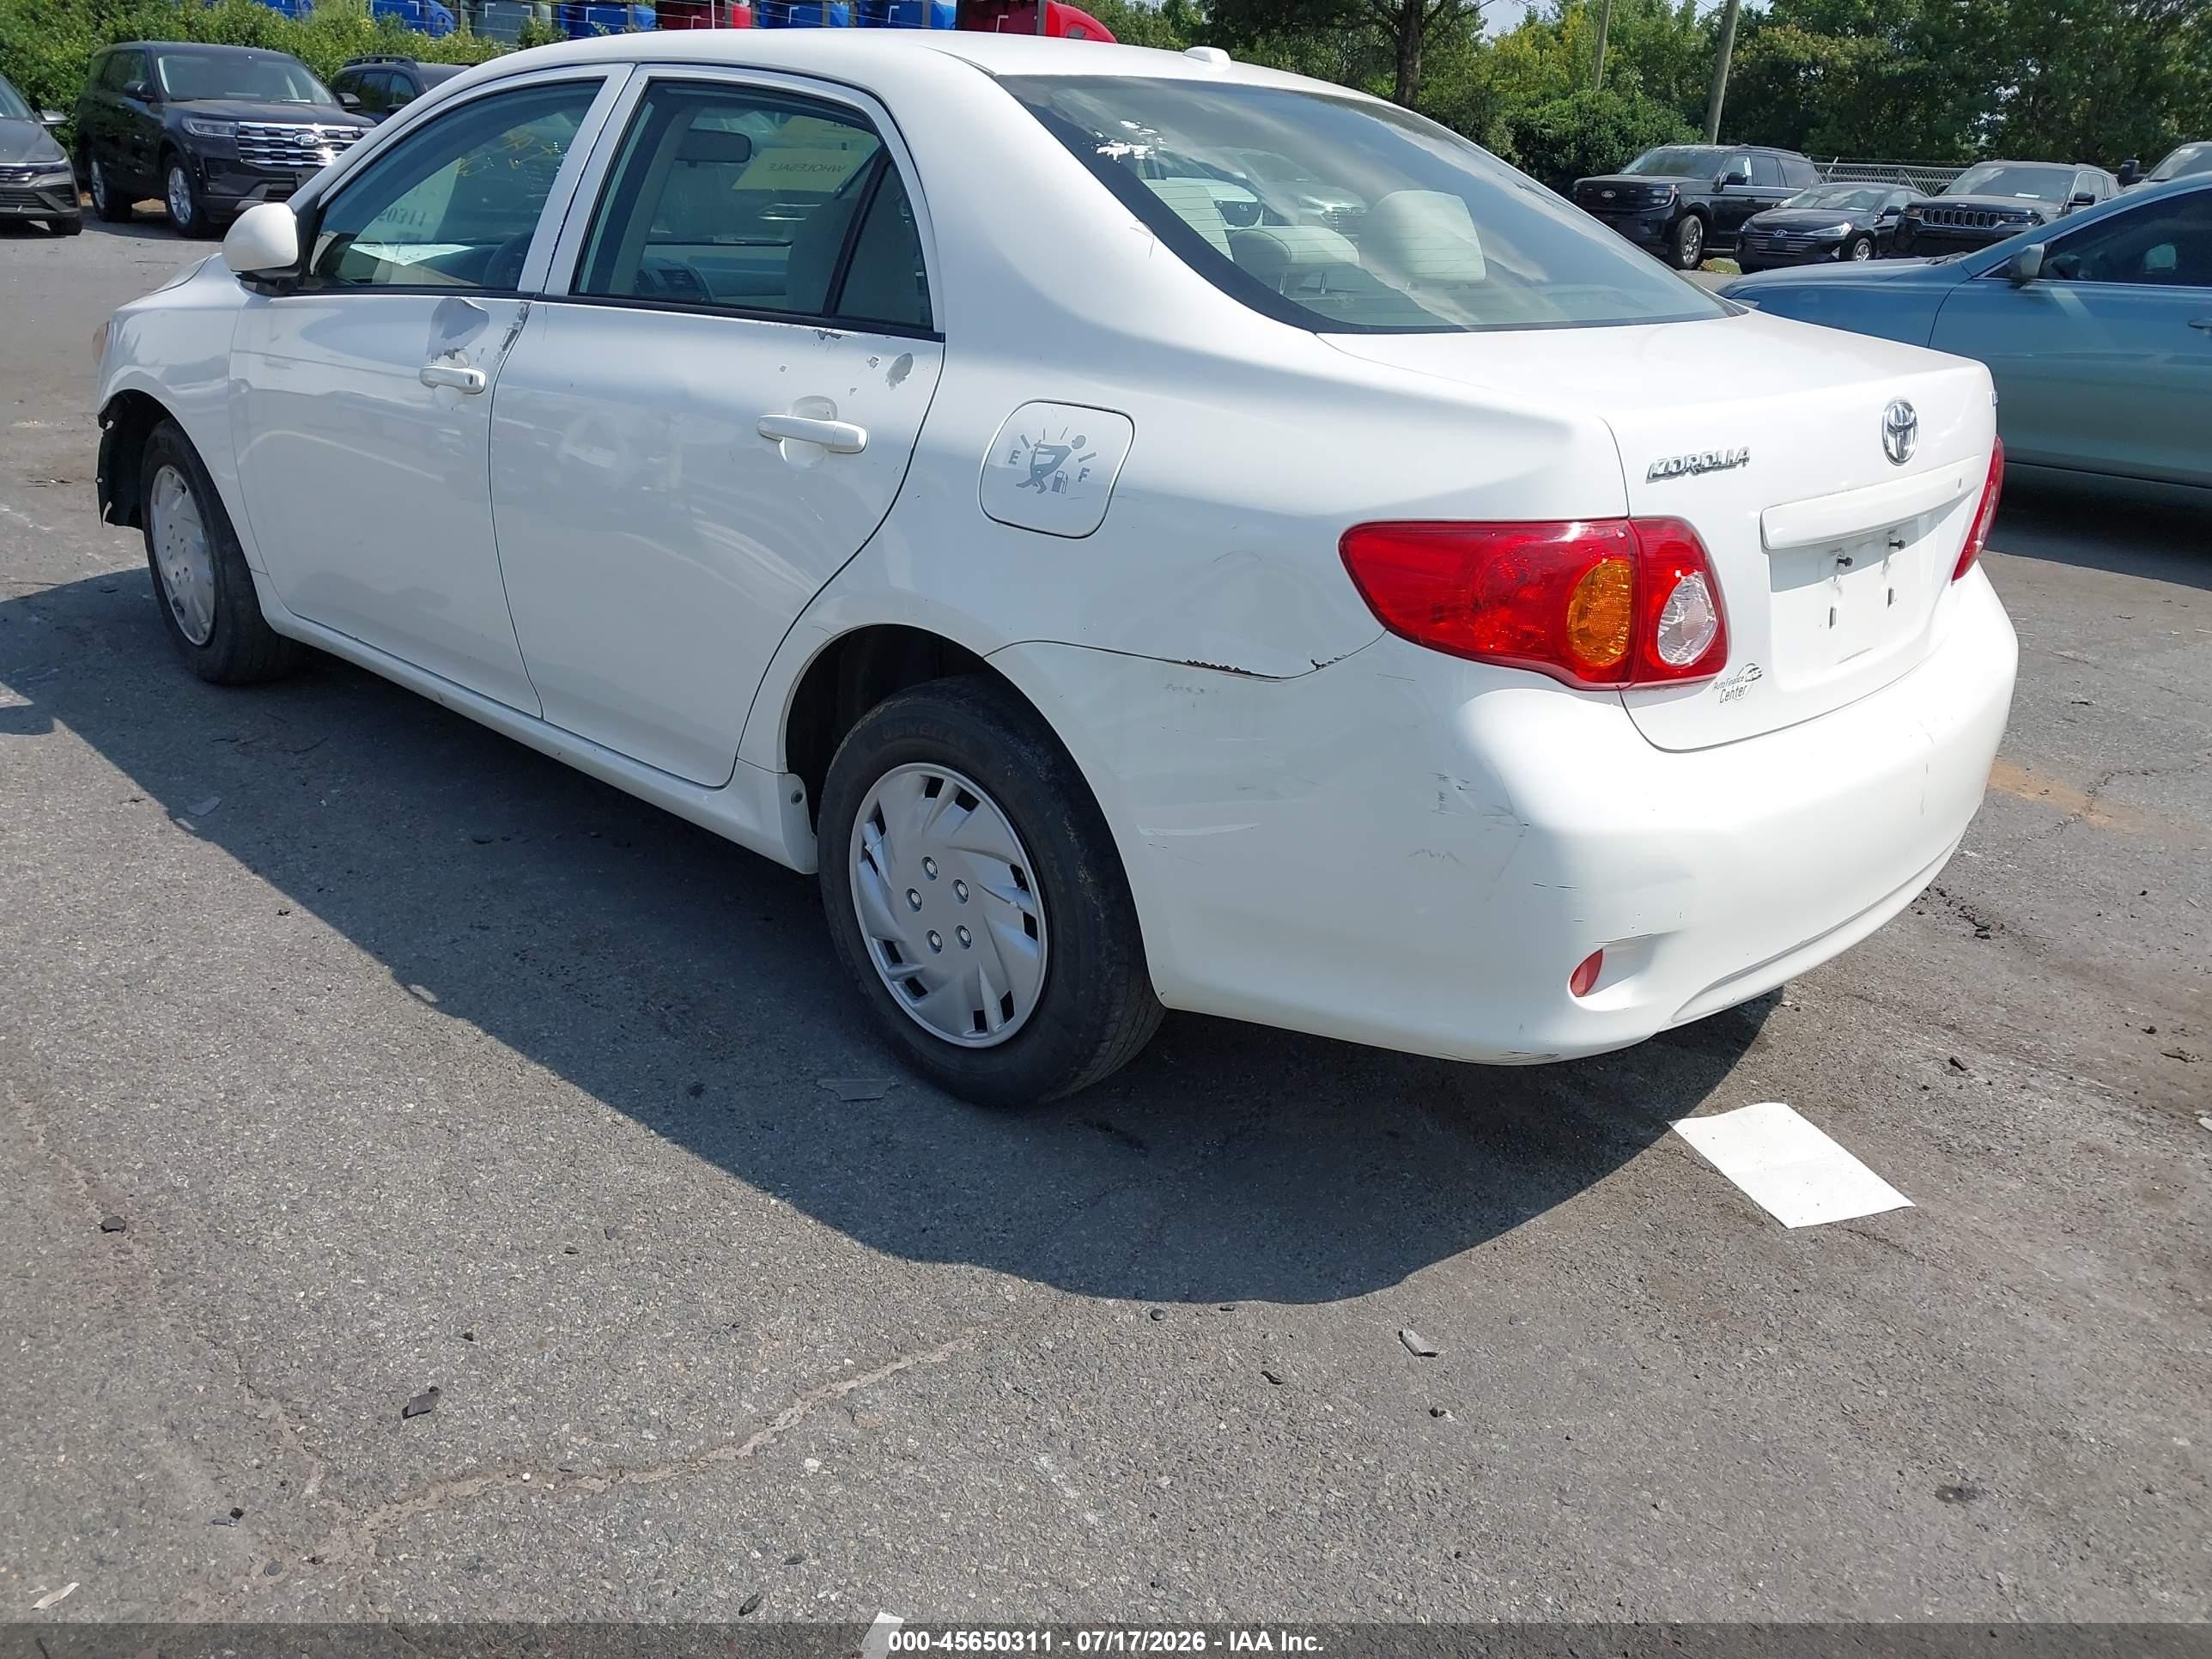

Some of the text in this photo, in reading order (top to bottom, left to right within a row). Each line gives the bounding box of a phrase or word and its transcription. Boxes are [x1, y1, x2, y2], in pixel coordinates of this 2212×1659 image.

[1008, 450, 1022, 465] E
[1078, 467, 1091, 482] F
[1720, 685, 1747, 703] Center
